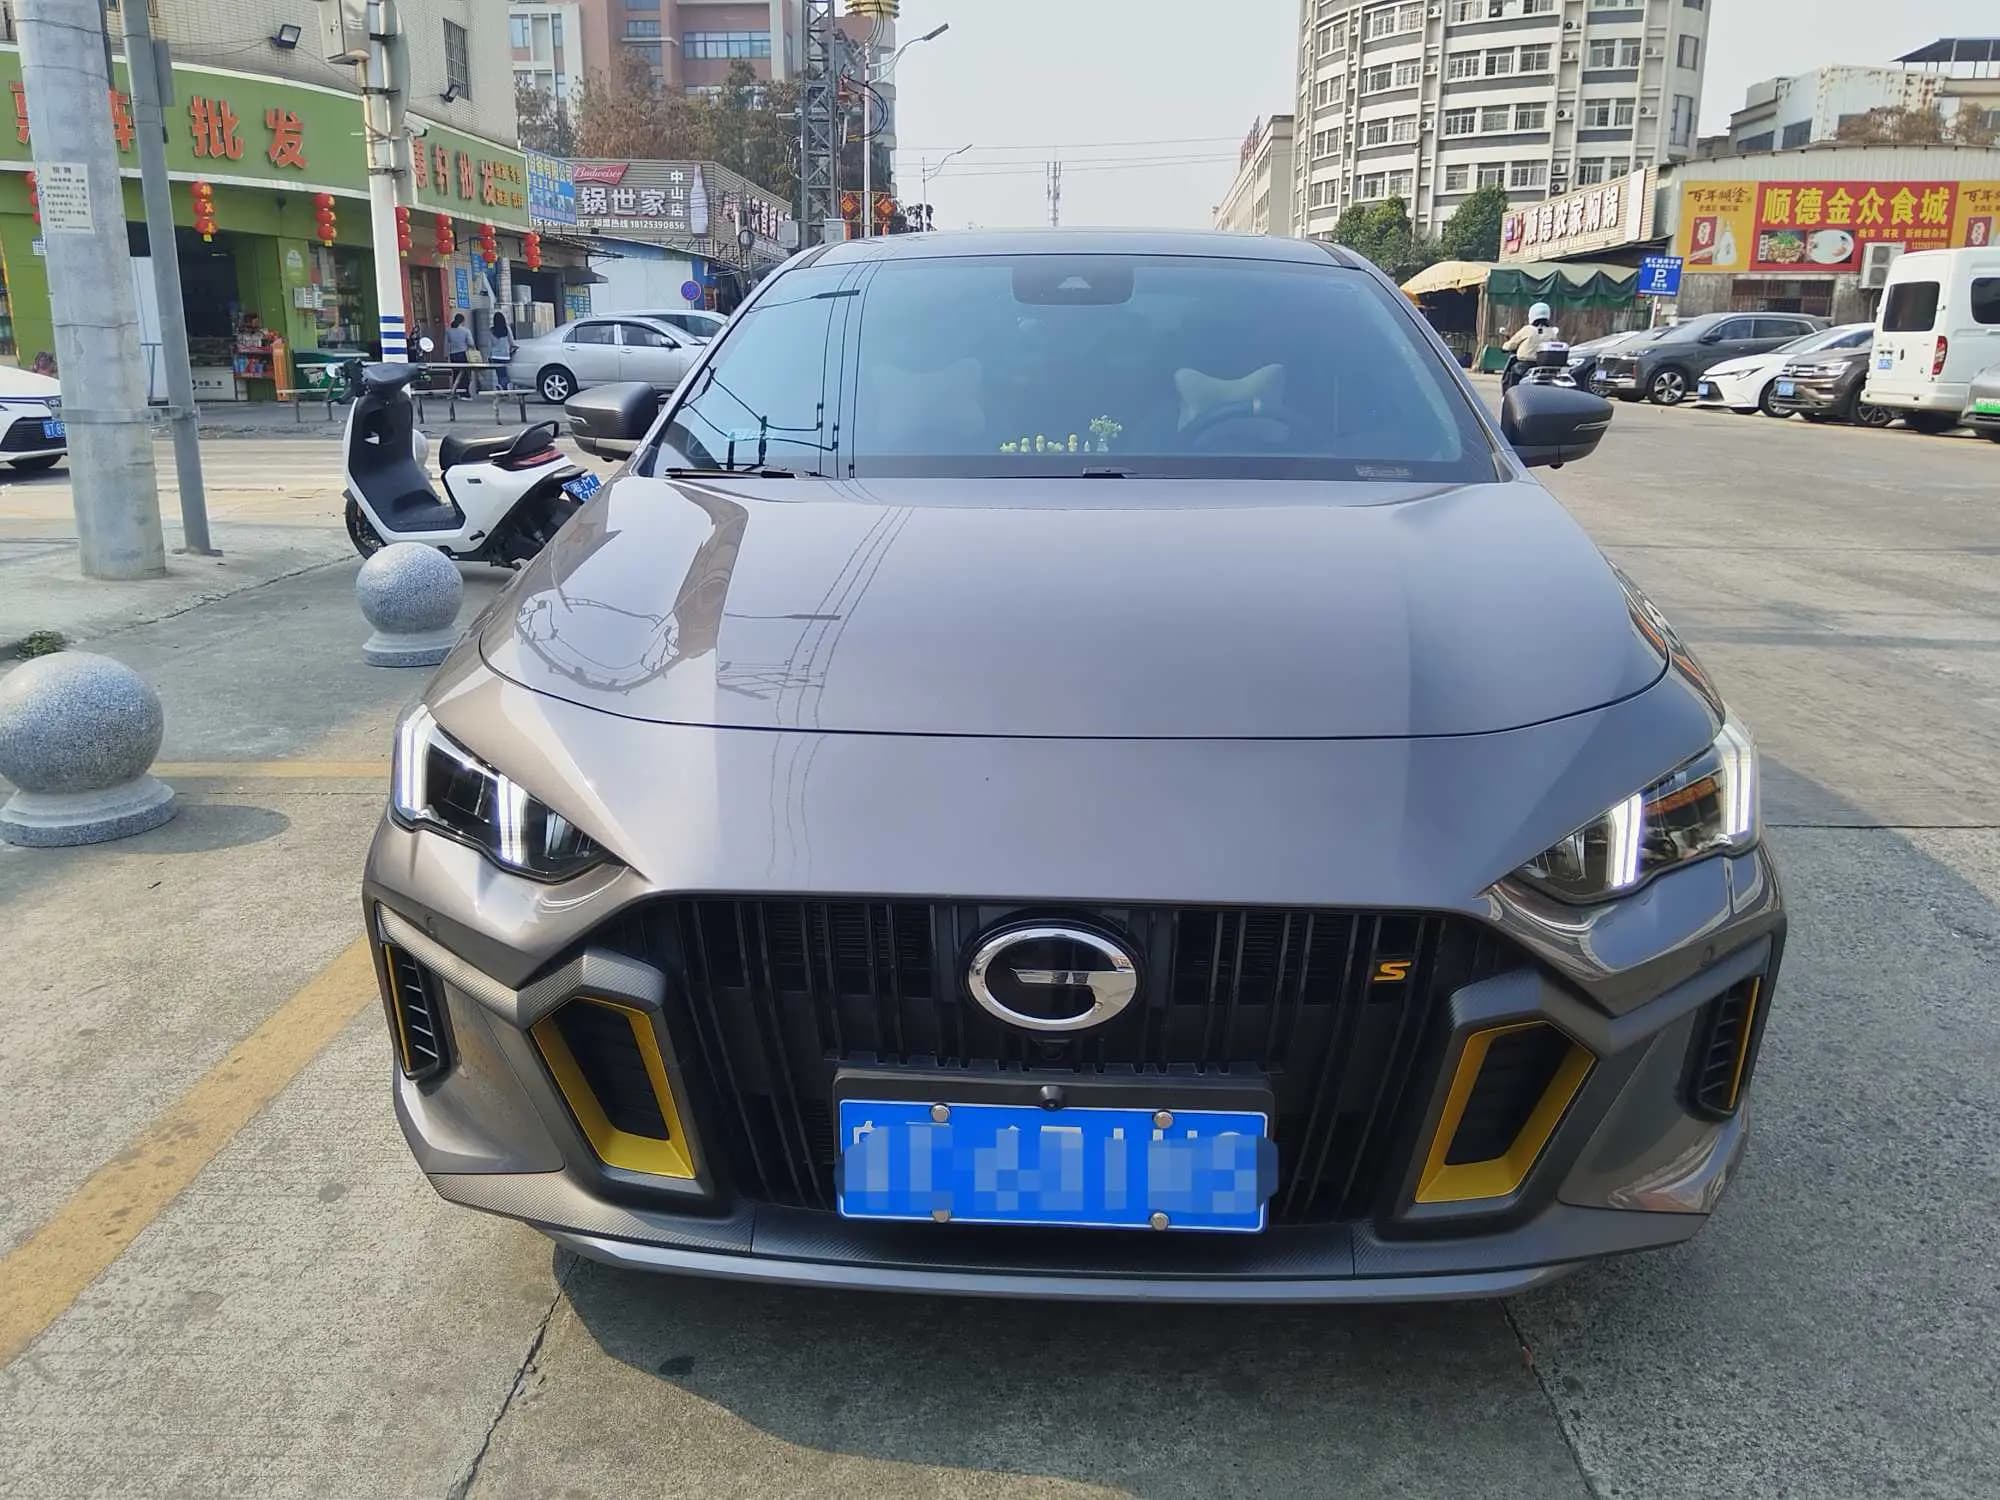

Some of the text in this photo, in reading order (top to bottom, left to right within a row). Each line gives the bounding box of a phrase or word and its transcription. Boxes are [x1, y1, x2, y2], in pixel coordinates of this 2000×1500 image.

[9, 80, 308, 169] 批发
[574, 166, 623, 178] Budweiser
[581, 186, 666, 217] 锅世家
[671, 169, 684, 217] 中山店
[1762, 186, 1950, 225] 顺德金众食城
[1374, 960, 1411, 981] S
